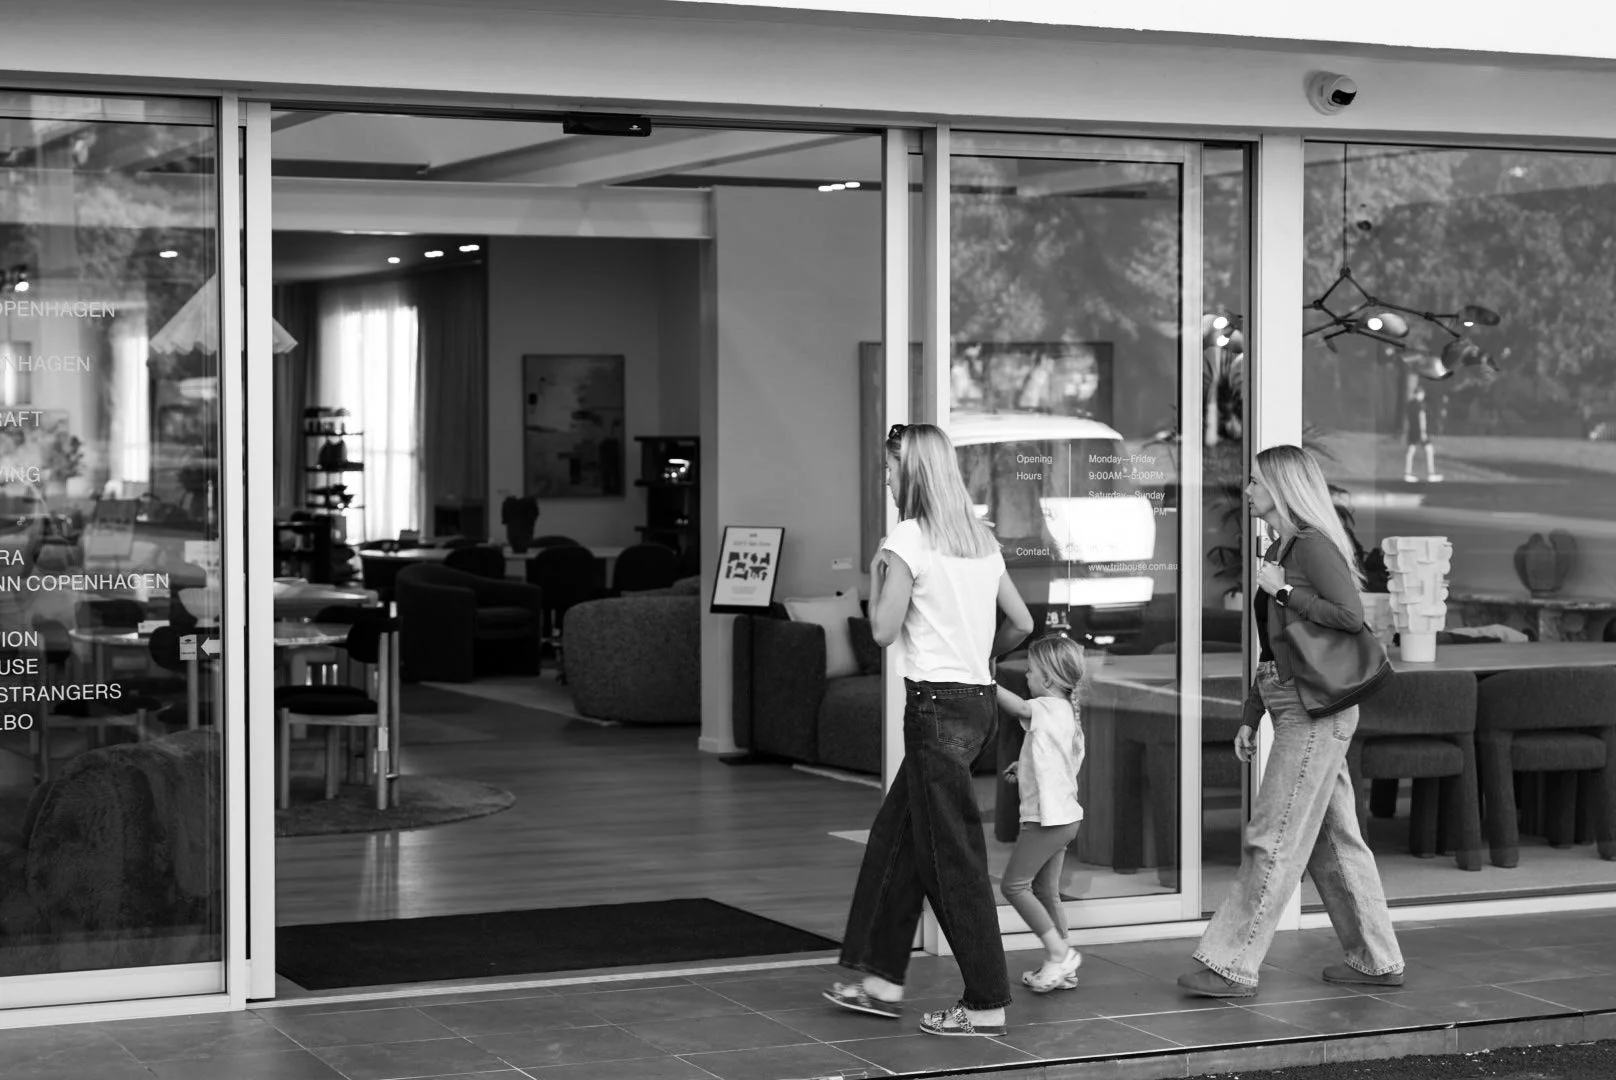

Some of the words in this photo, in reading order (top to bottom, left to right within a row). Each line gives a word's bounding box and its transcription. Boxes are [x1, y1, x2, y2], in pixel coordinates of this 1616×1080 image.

[0, 300, 115, 318] PENHAGEN
[0, 410, 43, 427] AFT
[1016, 453, 1053, 465] Opening
[1016, 471, 1042, 481] Hours
[1016, 547, 1050, 557] Contact
[26, 573, 169, 592] COPENHAGEN
[0, 630, 38, 647] ION
[0, 658, 39, 676] USE
[0, 683, 122, 703] STRANGERS
[0, 713, 34, 731] BO
